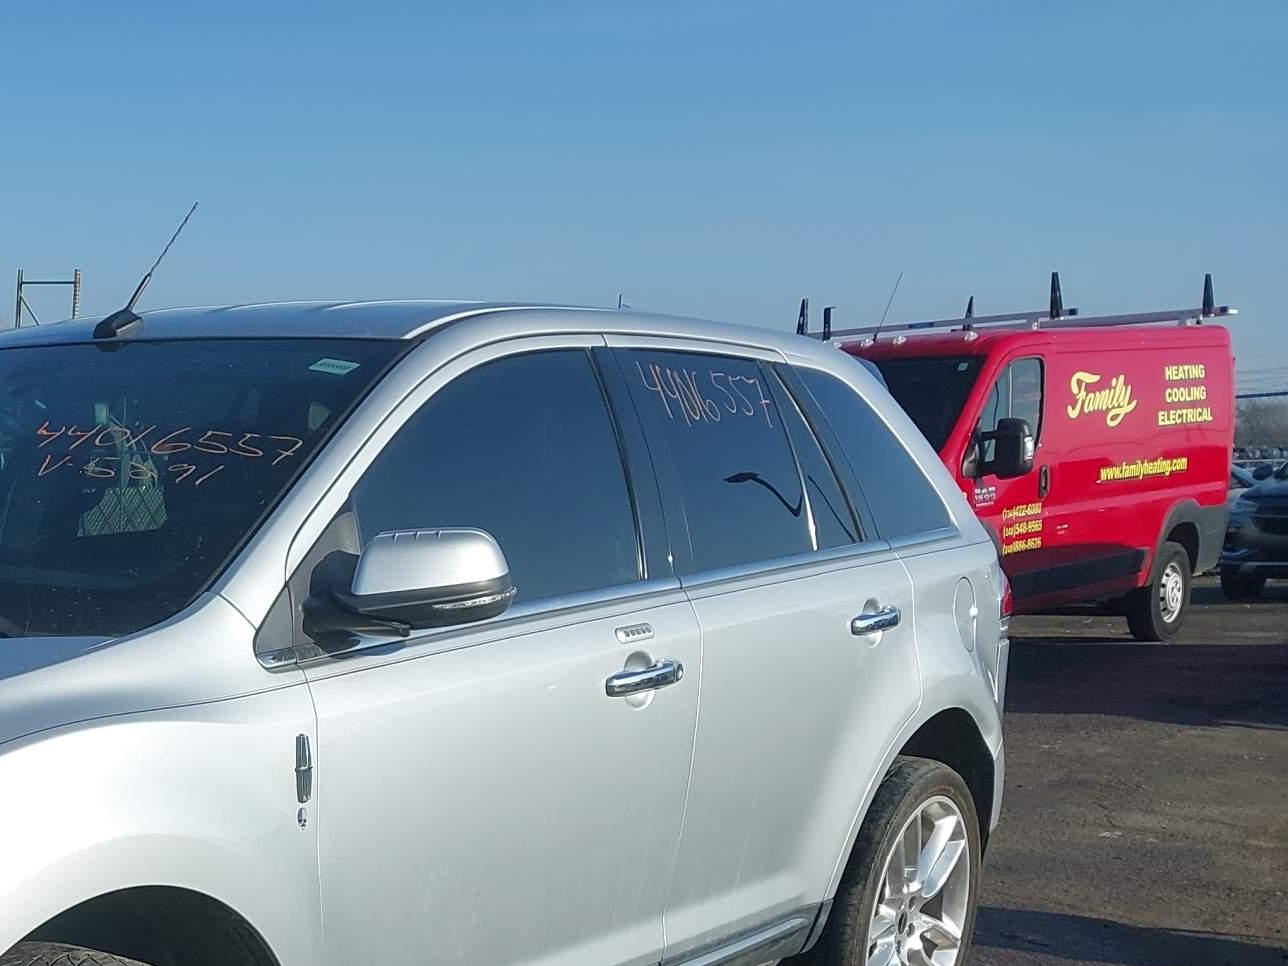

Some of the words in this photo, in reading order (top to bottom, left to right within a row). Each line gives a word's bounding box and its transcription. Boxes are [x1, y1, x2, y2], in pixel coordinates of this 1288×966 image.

[1165, 364, 1206, 381] HEATING
[1067, 371, 1138, 427] Family
[1165, 386, 1207, 403] COOLING
[1158, 407, 1214, 426] ELECTRICAL
[36, 420, 303, 466] 44016557
[1099, 456, 1188, 480] www.familyheating.com
